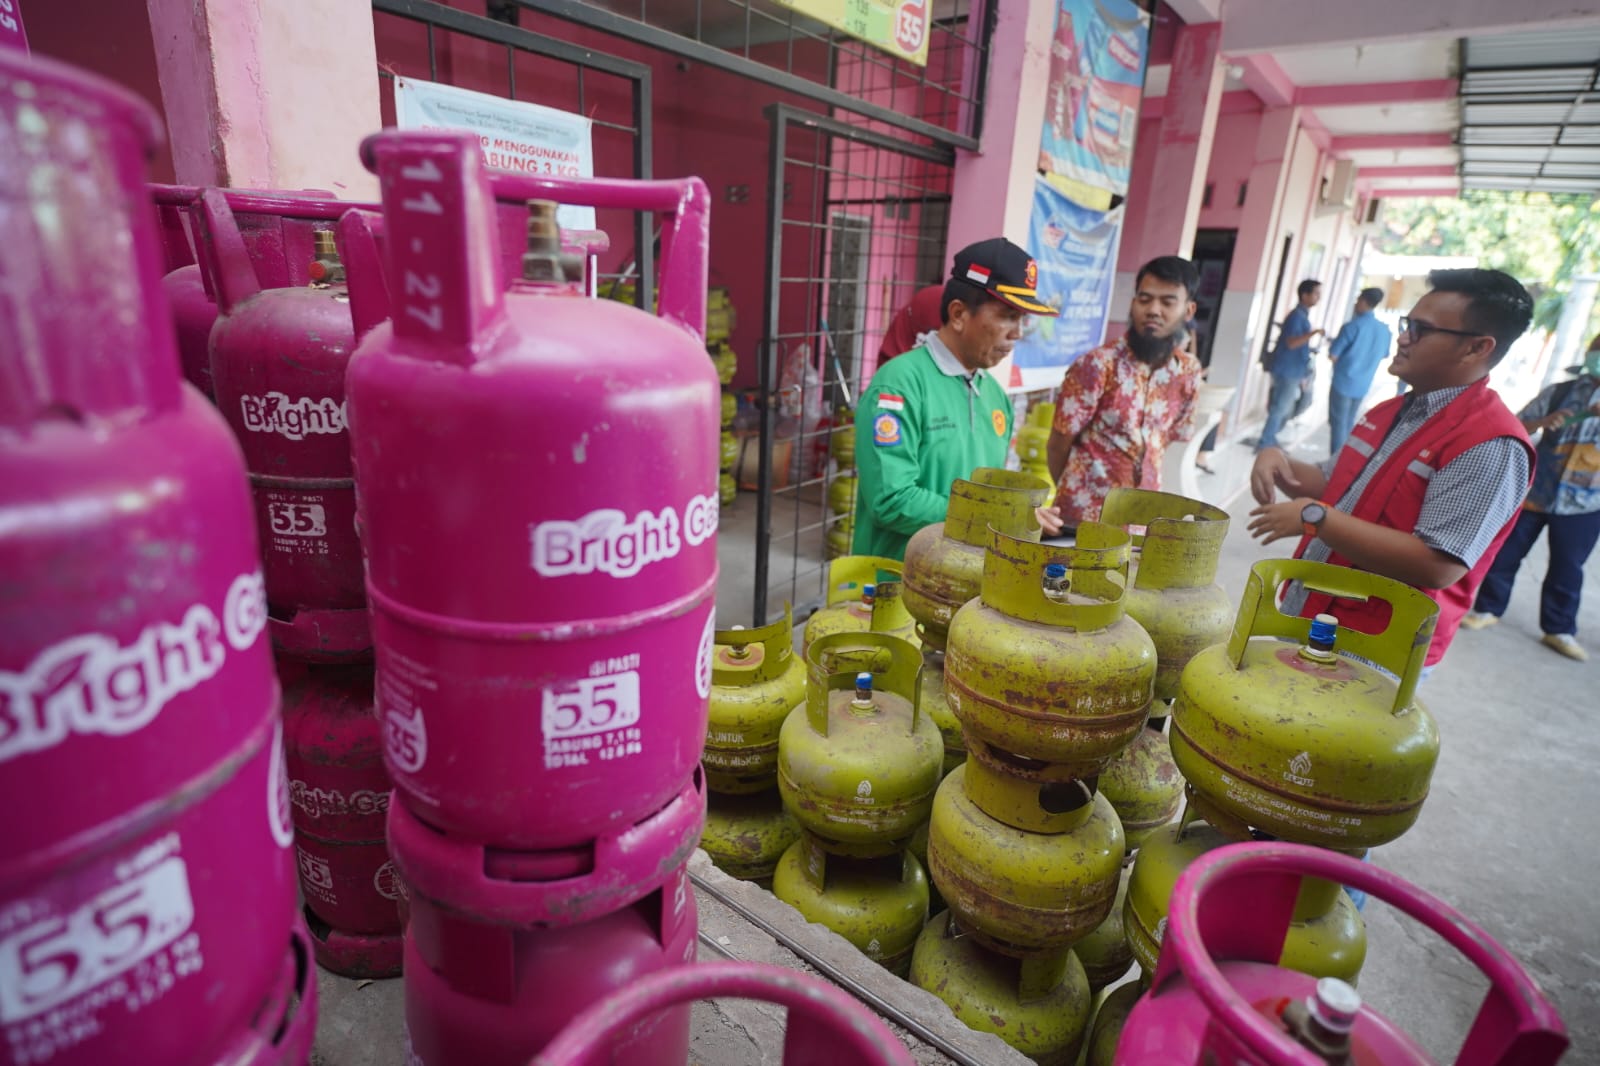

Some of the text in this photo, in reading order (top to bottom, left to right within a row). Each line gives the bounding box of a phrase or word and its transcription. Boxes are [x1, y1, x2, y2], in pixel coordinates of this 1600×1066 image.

[494, 138, 580, 164] MENGGUNAKAN
[543, 162, 553, 176] 3
[242, 393, 340, 438] Bright
[537, 495, 718, 574] Bright Ga
[607, 653, 640, 674] PASTI
[714, 731, 745, 743] UNTUK
[544, 751, 590, 769] TOTAL
